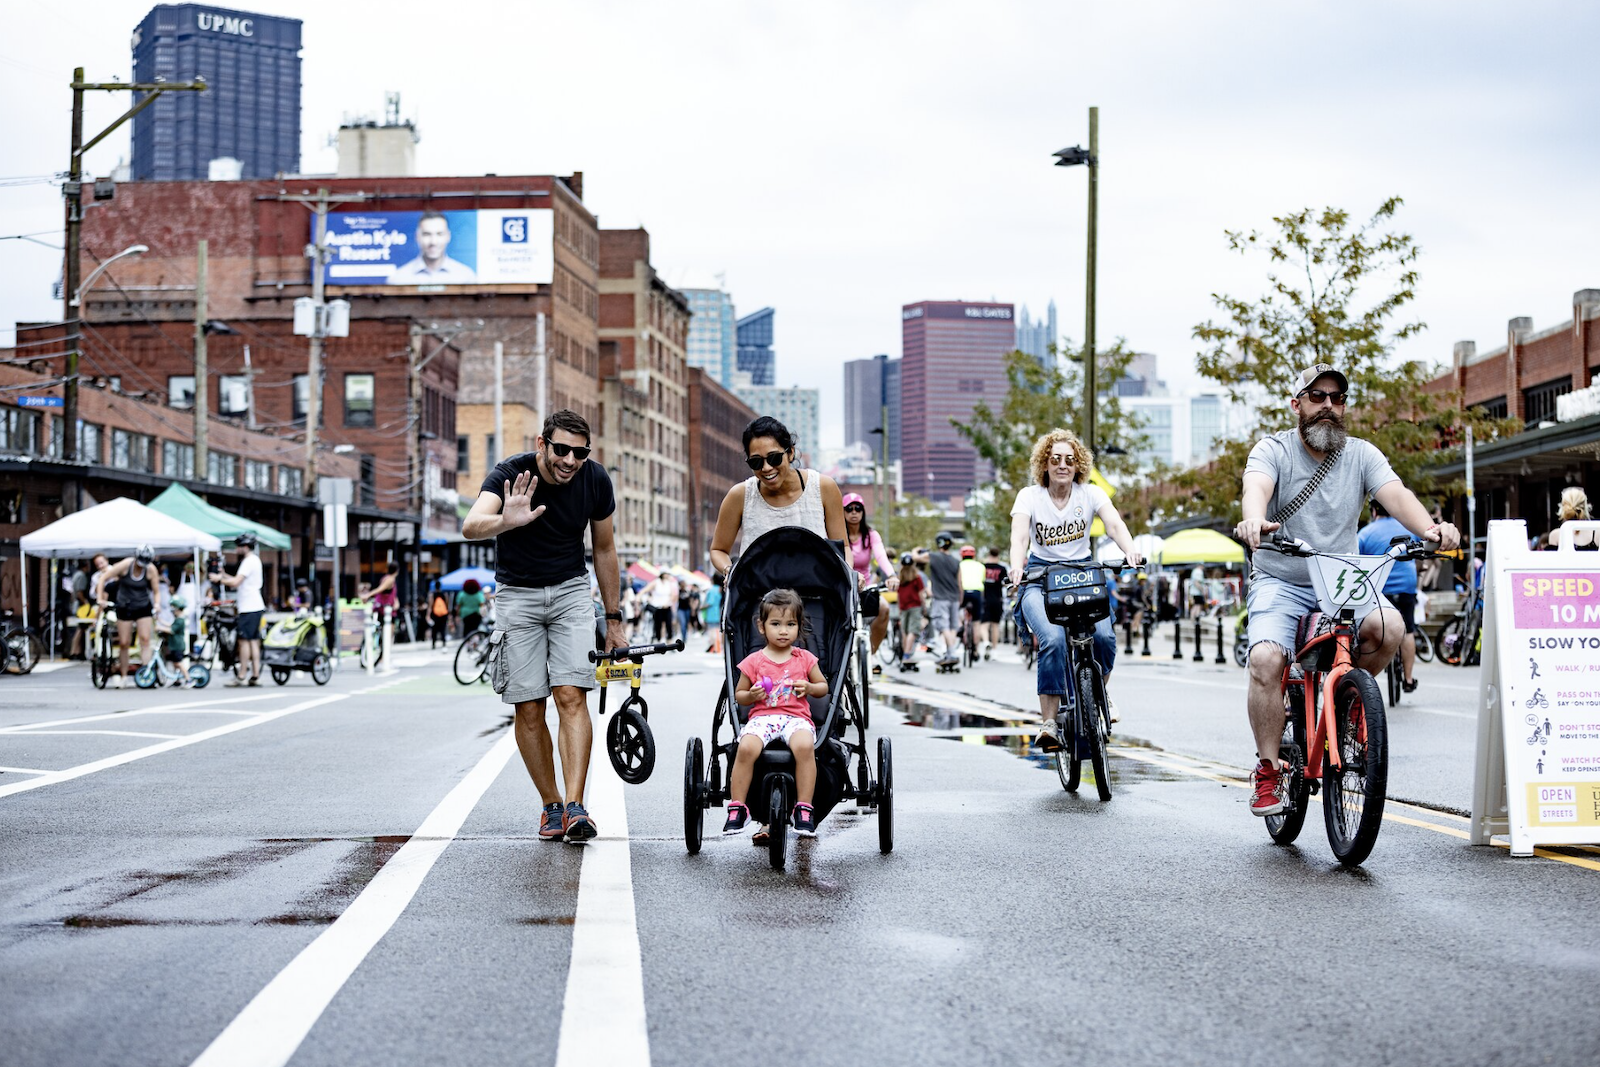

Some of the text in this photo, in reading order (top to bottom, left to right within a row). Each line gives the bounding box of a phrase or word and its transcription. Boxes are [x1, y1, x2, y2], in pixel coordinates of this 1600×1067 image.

[197, 12, 254, 37] UPMC
[323, 229, 407, 248] Austin Kyle
[1035, 519, 1087, 546] Steelers
[1054, 570, 1094, 586] POGOH
[1523, 578, 1594, 597] SPEED
[1550, 604, 1600, 623] 10 M
[628, 645, 655, 655] STRIDER
[1529, 637, 1600, 649] SLOW YO
[610, 668, 628, 678] SUZUKI
[1555, 664, 1579, 672] WALK
[1541, 788, 1572, 801] OPEN
[1542, 809, 1574, 818] STREETS
